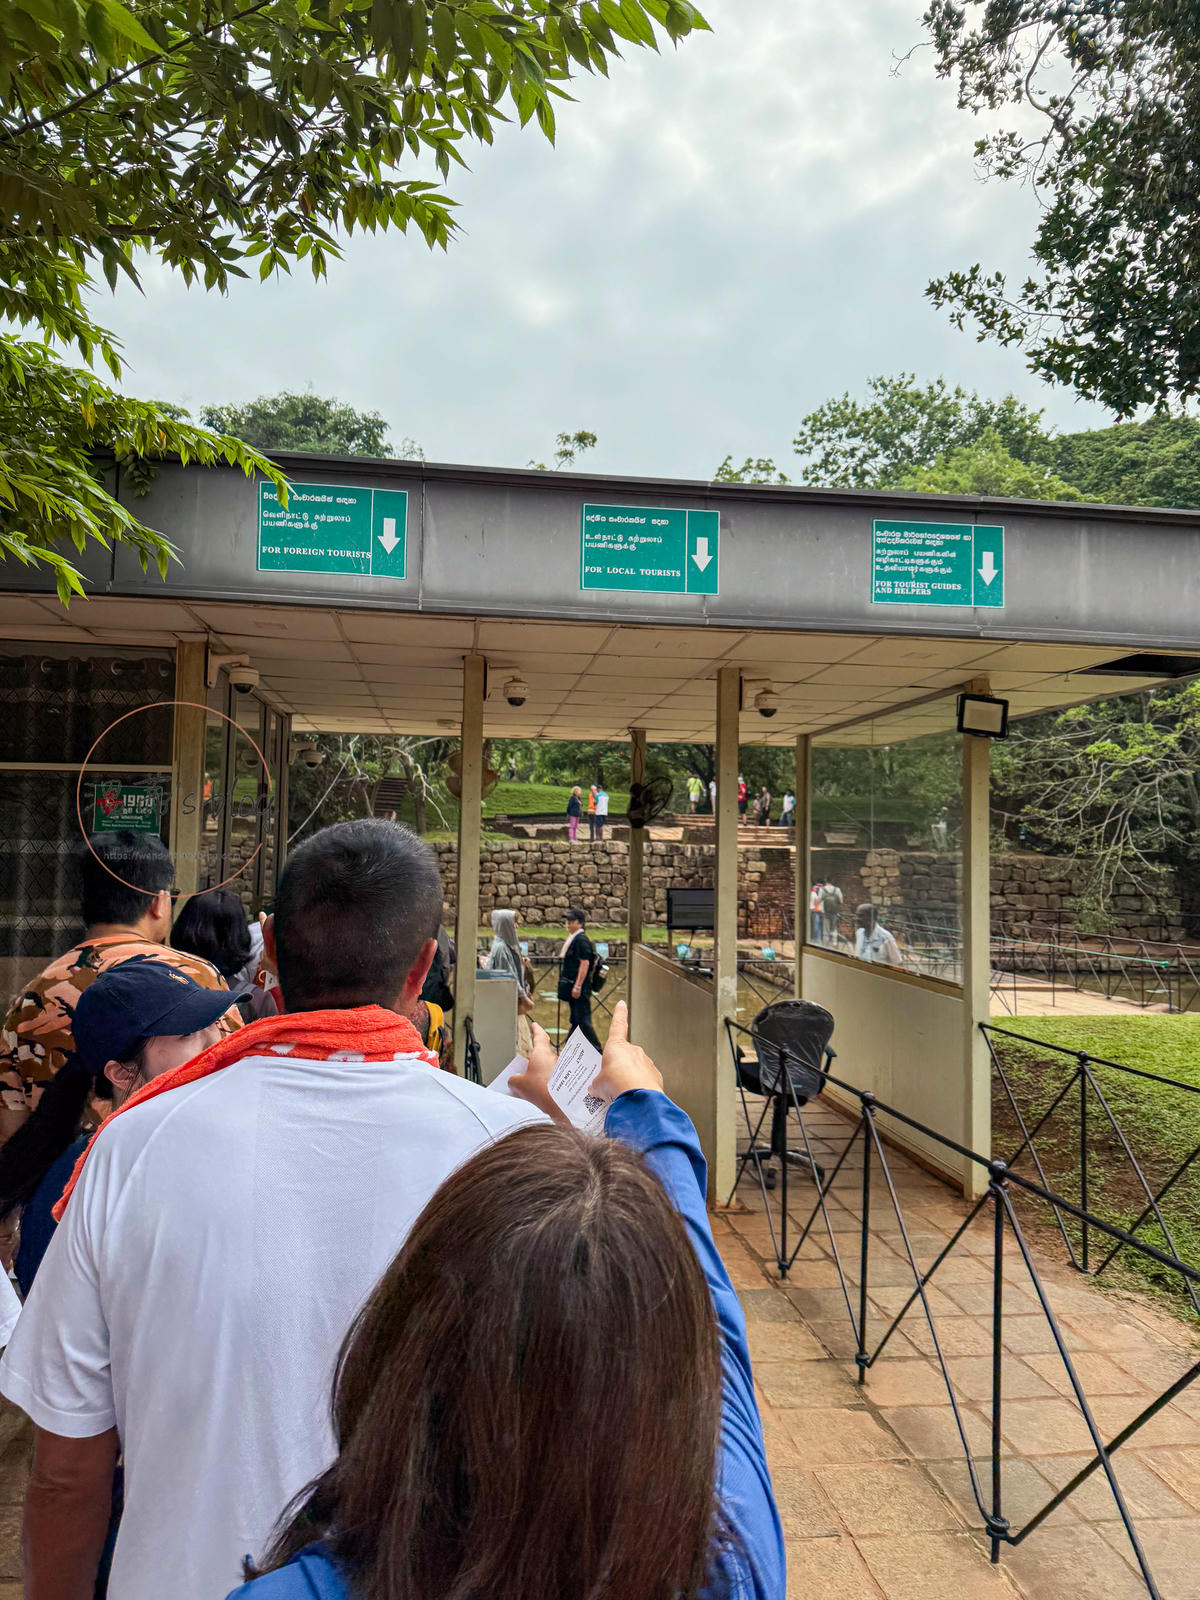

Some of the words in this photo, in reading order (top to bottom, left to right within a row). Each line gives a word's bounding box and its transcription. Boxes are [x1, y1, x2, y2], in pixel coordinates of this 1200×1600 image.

[262, 546, 281, 554] FOR
[284, 547, 325, 556] FOREIGN
[327, 549, 372, 559] TOURISTS
[585, 566, 602, 574] FOR
[607, 567, 636, 575] LOCAL
[639, 568, 681, 577] TOURISTS
[875, 580, 892, 588] FOR
[894, 580, 929, 589] TOURIST
[931, 582, 962, 590] GUIDES
